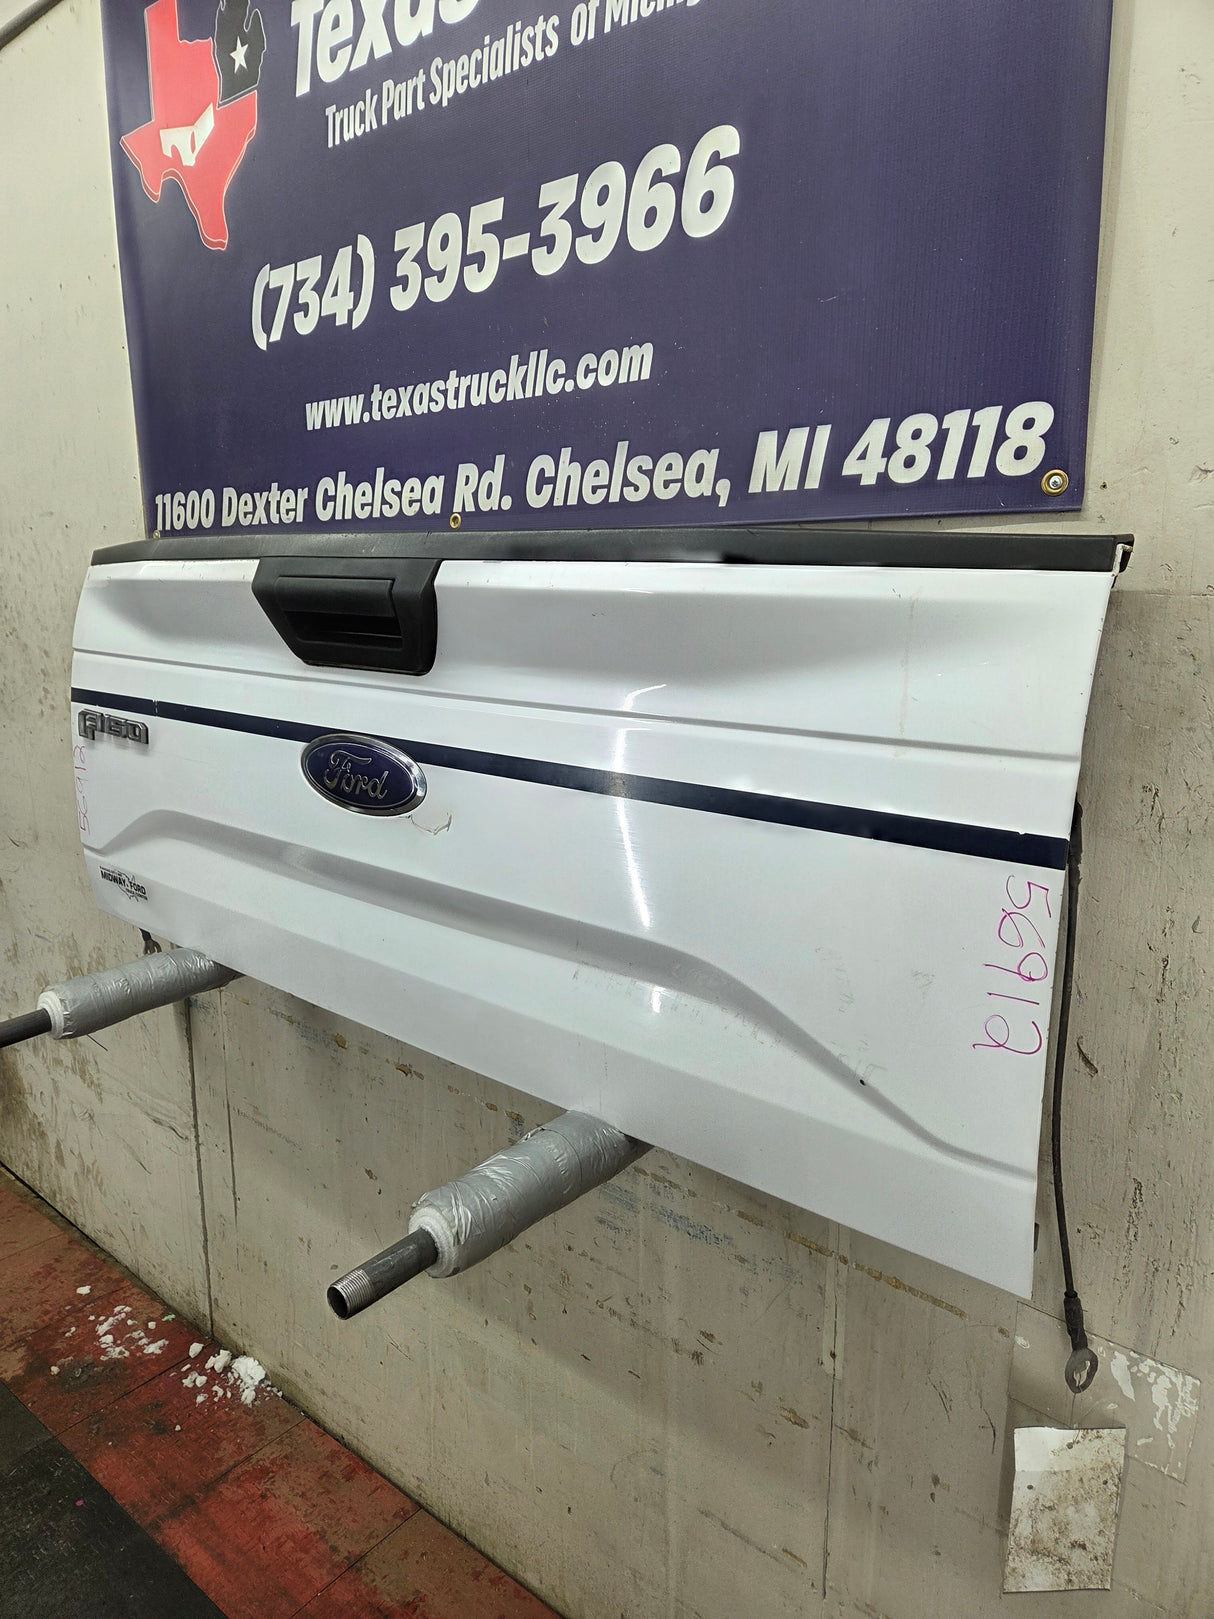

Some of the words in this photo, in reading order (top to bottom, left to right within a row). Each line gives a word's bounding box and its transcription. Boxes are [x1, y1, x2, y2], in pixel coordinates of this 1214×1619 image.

[291, 0, 479, 98] Texa
[326, 89, 378, 148] Truck
[382, 69, 426, 127] Part
[429, 14, 560, 107] Specialists
[570, 0, 599, 46] of
[252, 233, 375, 350] (734)
[390, 125, 740, 312] 395-3966
[305, 342, 654, 431] www.texastruckllc.com
[155, 488, 214, 531] 11600
[222, 484, 308, 527] Dexter
[316, 467, 444, 521] Chelsea
[453, 454, 512, 513] Rd.
[526, 440, 731, 508] Chelsea,
[749, 425, 831, 493] MI
[842, 401, 1055, 485] 48118
[323, 750, 390, 799] Ford
